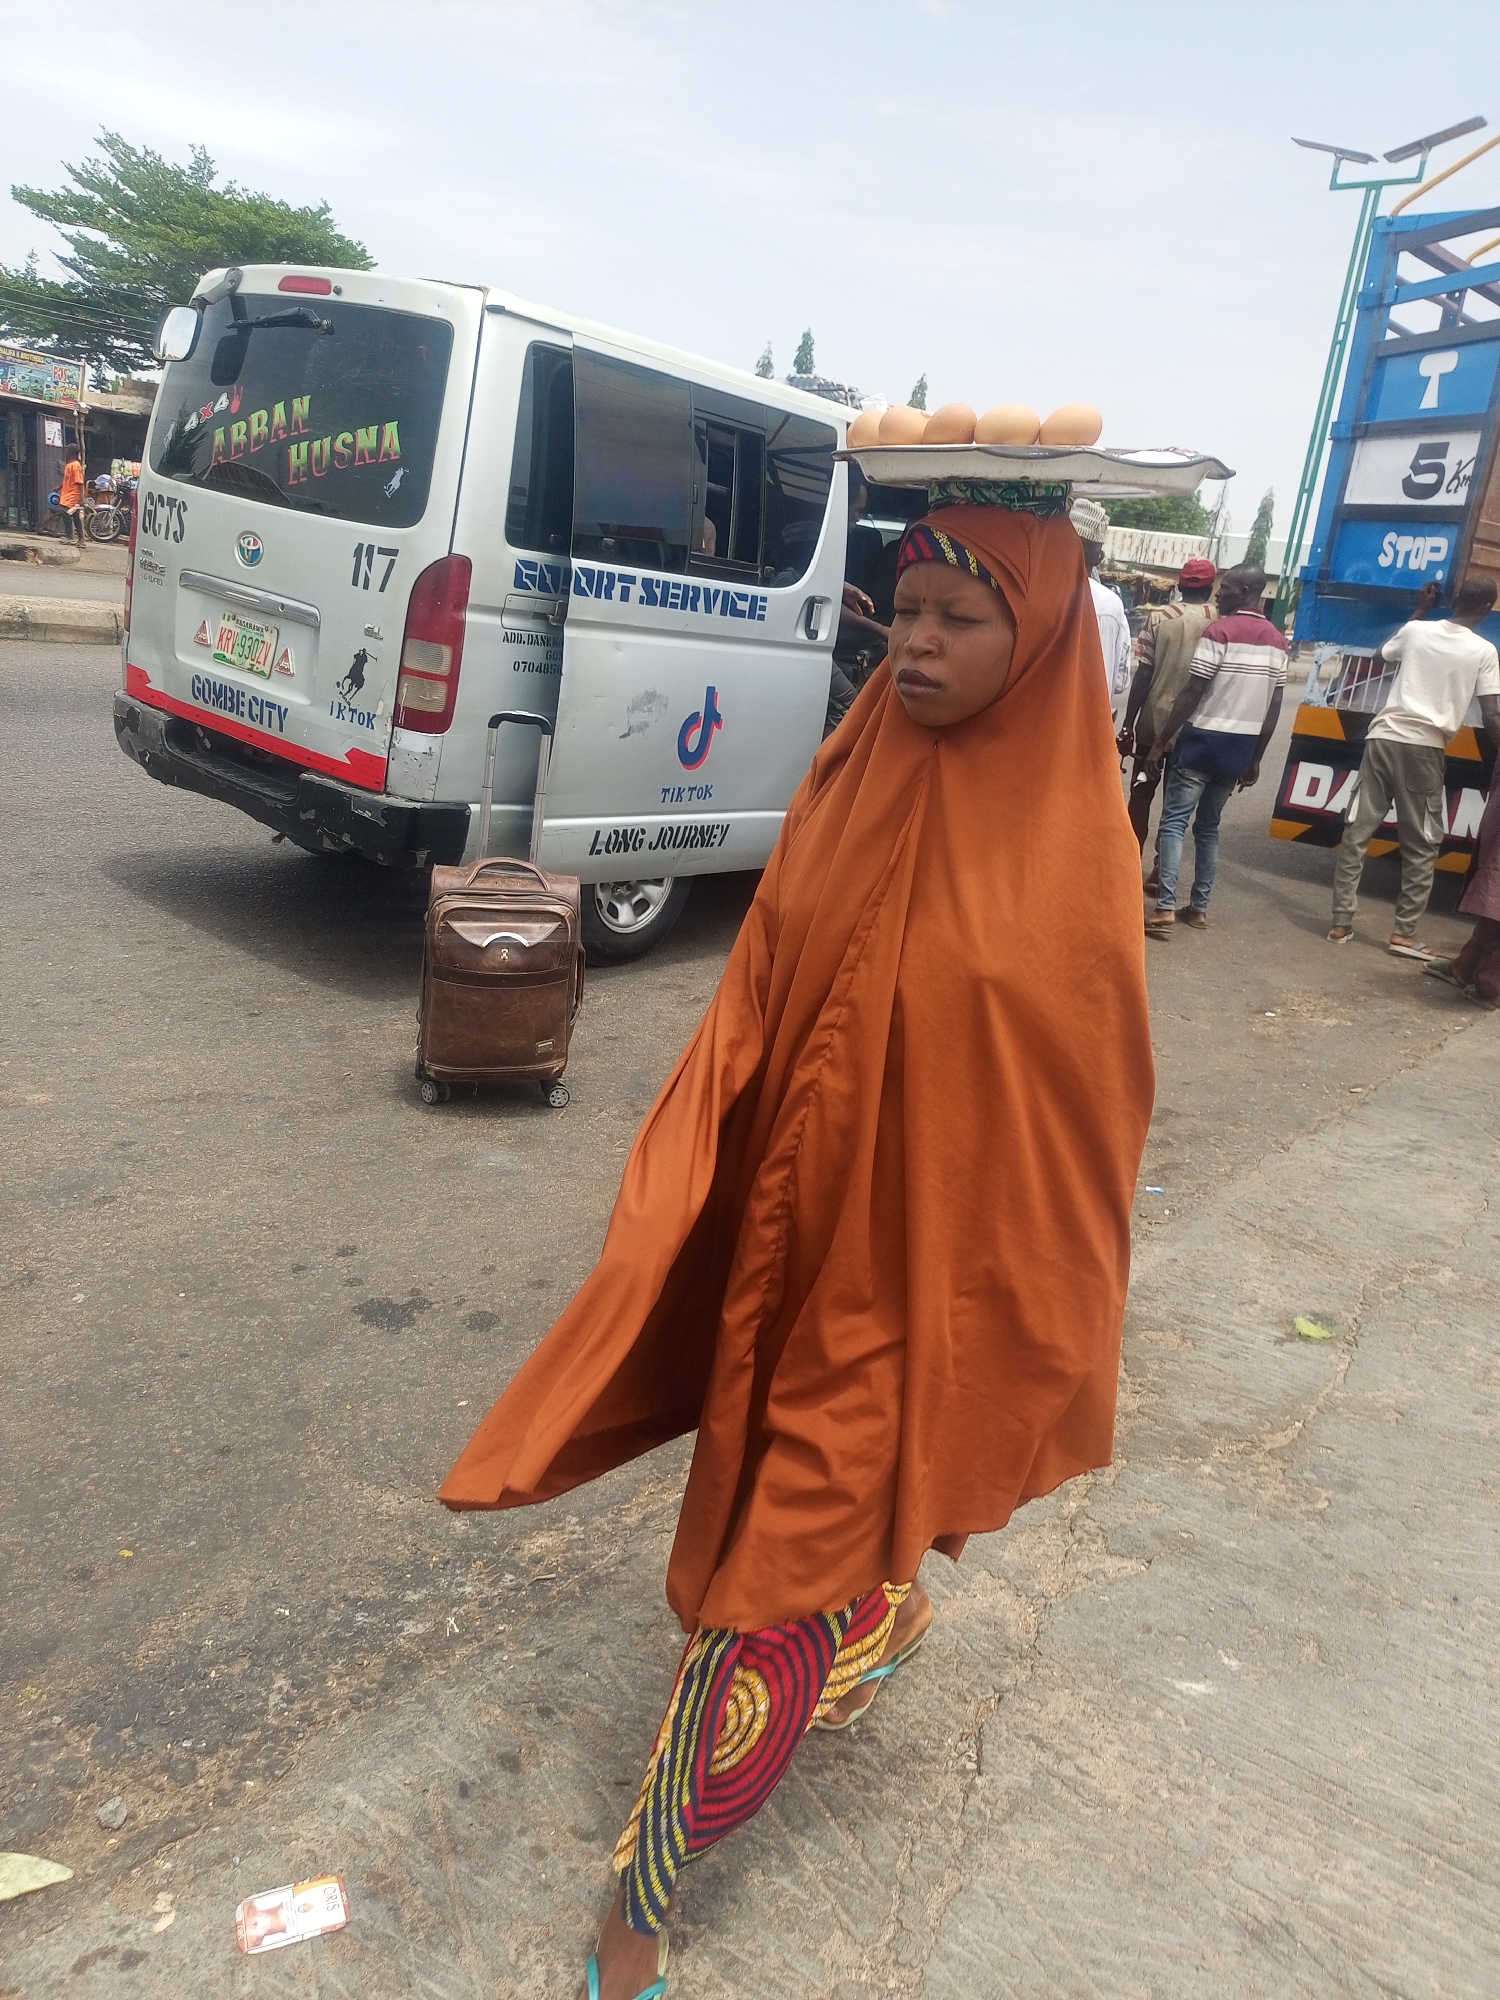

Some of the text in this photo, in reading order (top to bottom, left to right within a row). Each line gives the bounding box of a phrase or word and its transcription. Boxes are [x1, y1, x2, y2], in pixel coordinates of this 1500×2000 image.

[53, 366, 68, 382] POS
[1419, 350, 1459, 409] T
[213, 395, 311, 466] ABBAN
[289, 421, 401, 485] HUSNA
[1402, 442, 1450, 500] 5
[351, 543, 400, 593] 117
[639, 577, 768, 622] SERVICE
[545, 649, 563, 662] GO
[191, 674, 291, 733] GOMBE CITY
[661, 784, 713, 804] TIKTOK
[589, 823, 731, 856] LONG JOURNEY
[323, 1886, 340, 1911] ORIS
